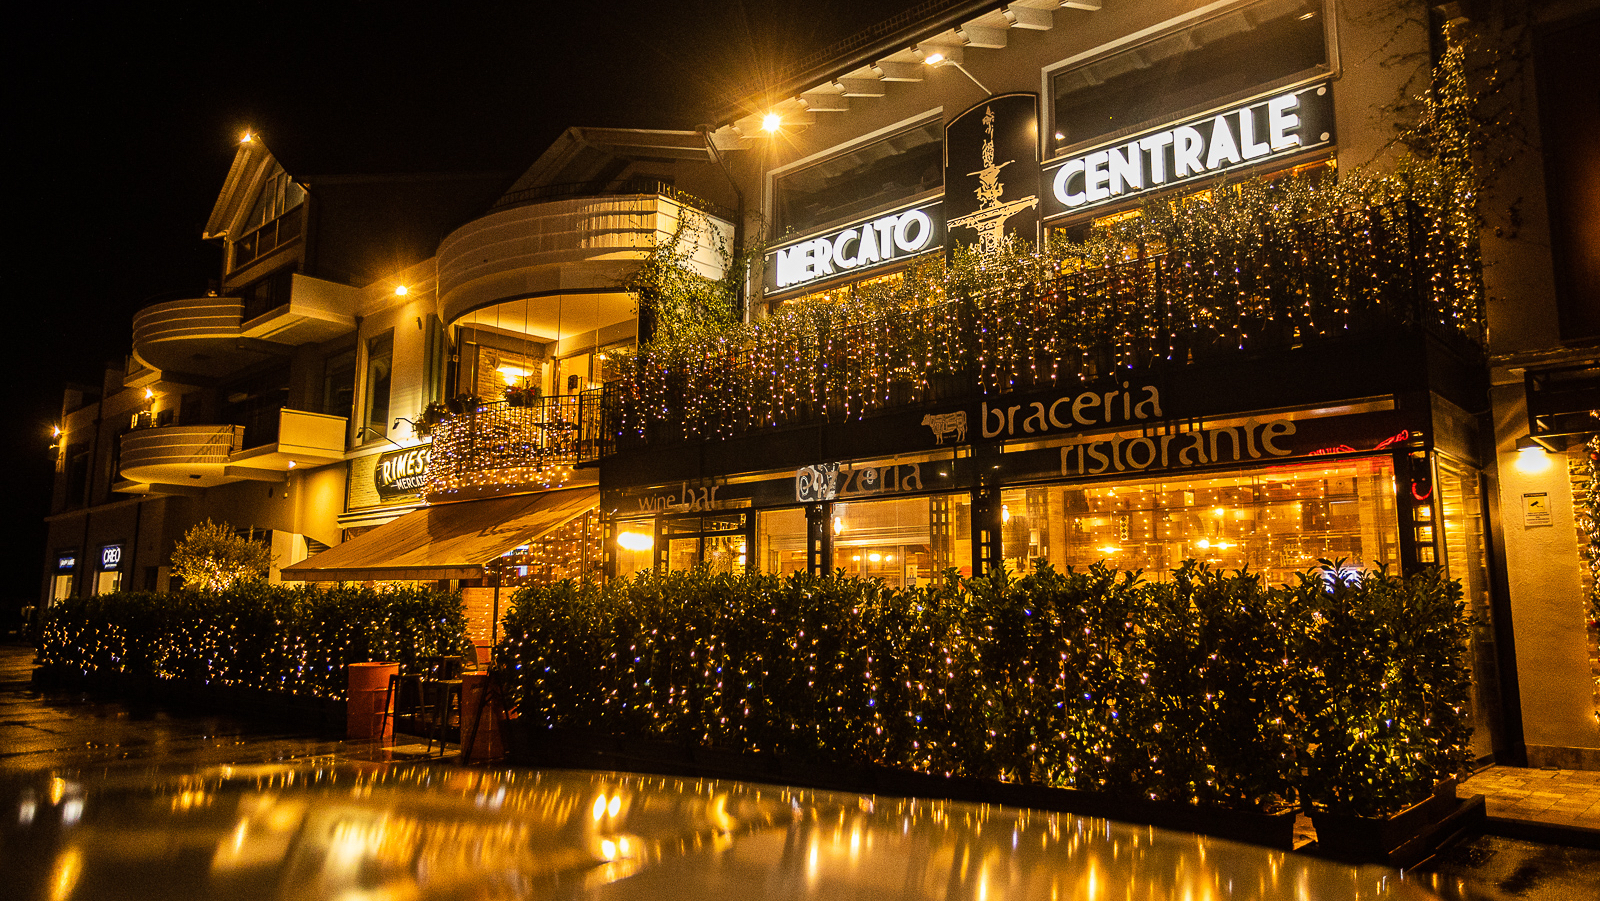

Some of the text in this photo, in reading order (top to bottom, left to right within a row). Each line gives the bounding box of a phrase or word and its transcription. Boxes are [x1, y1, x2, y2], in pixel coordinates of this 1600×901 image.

[776, 93, 1299, 287] MERCATO CENTRALE
[981, 381, 1163, 438] braceria
[1060, 416, 1297, 476] ristorante
[638, 482, 719, 512] wine bar
